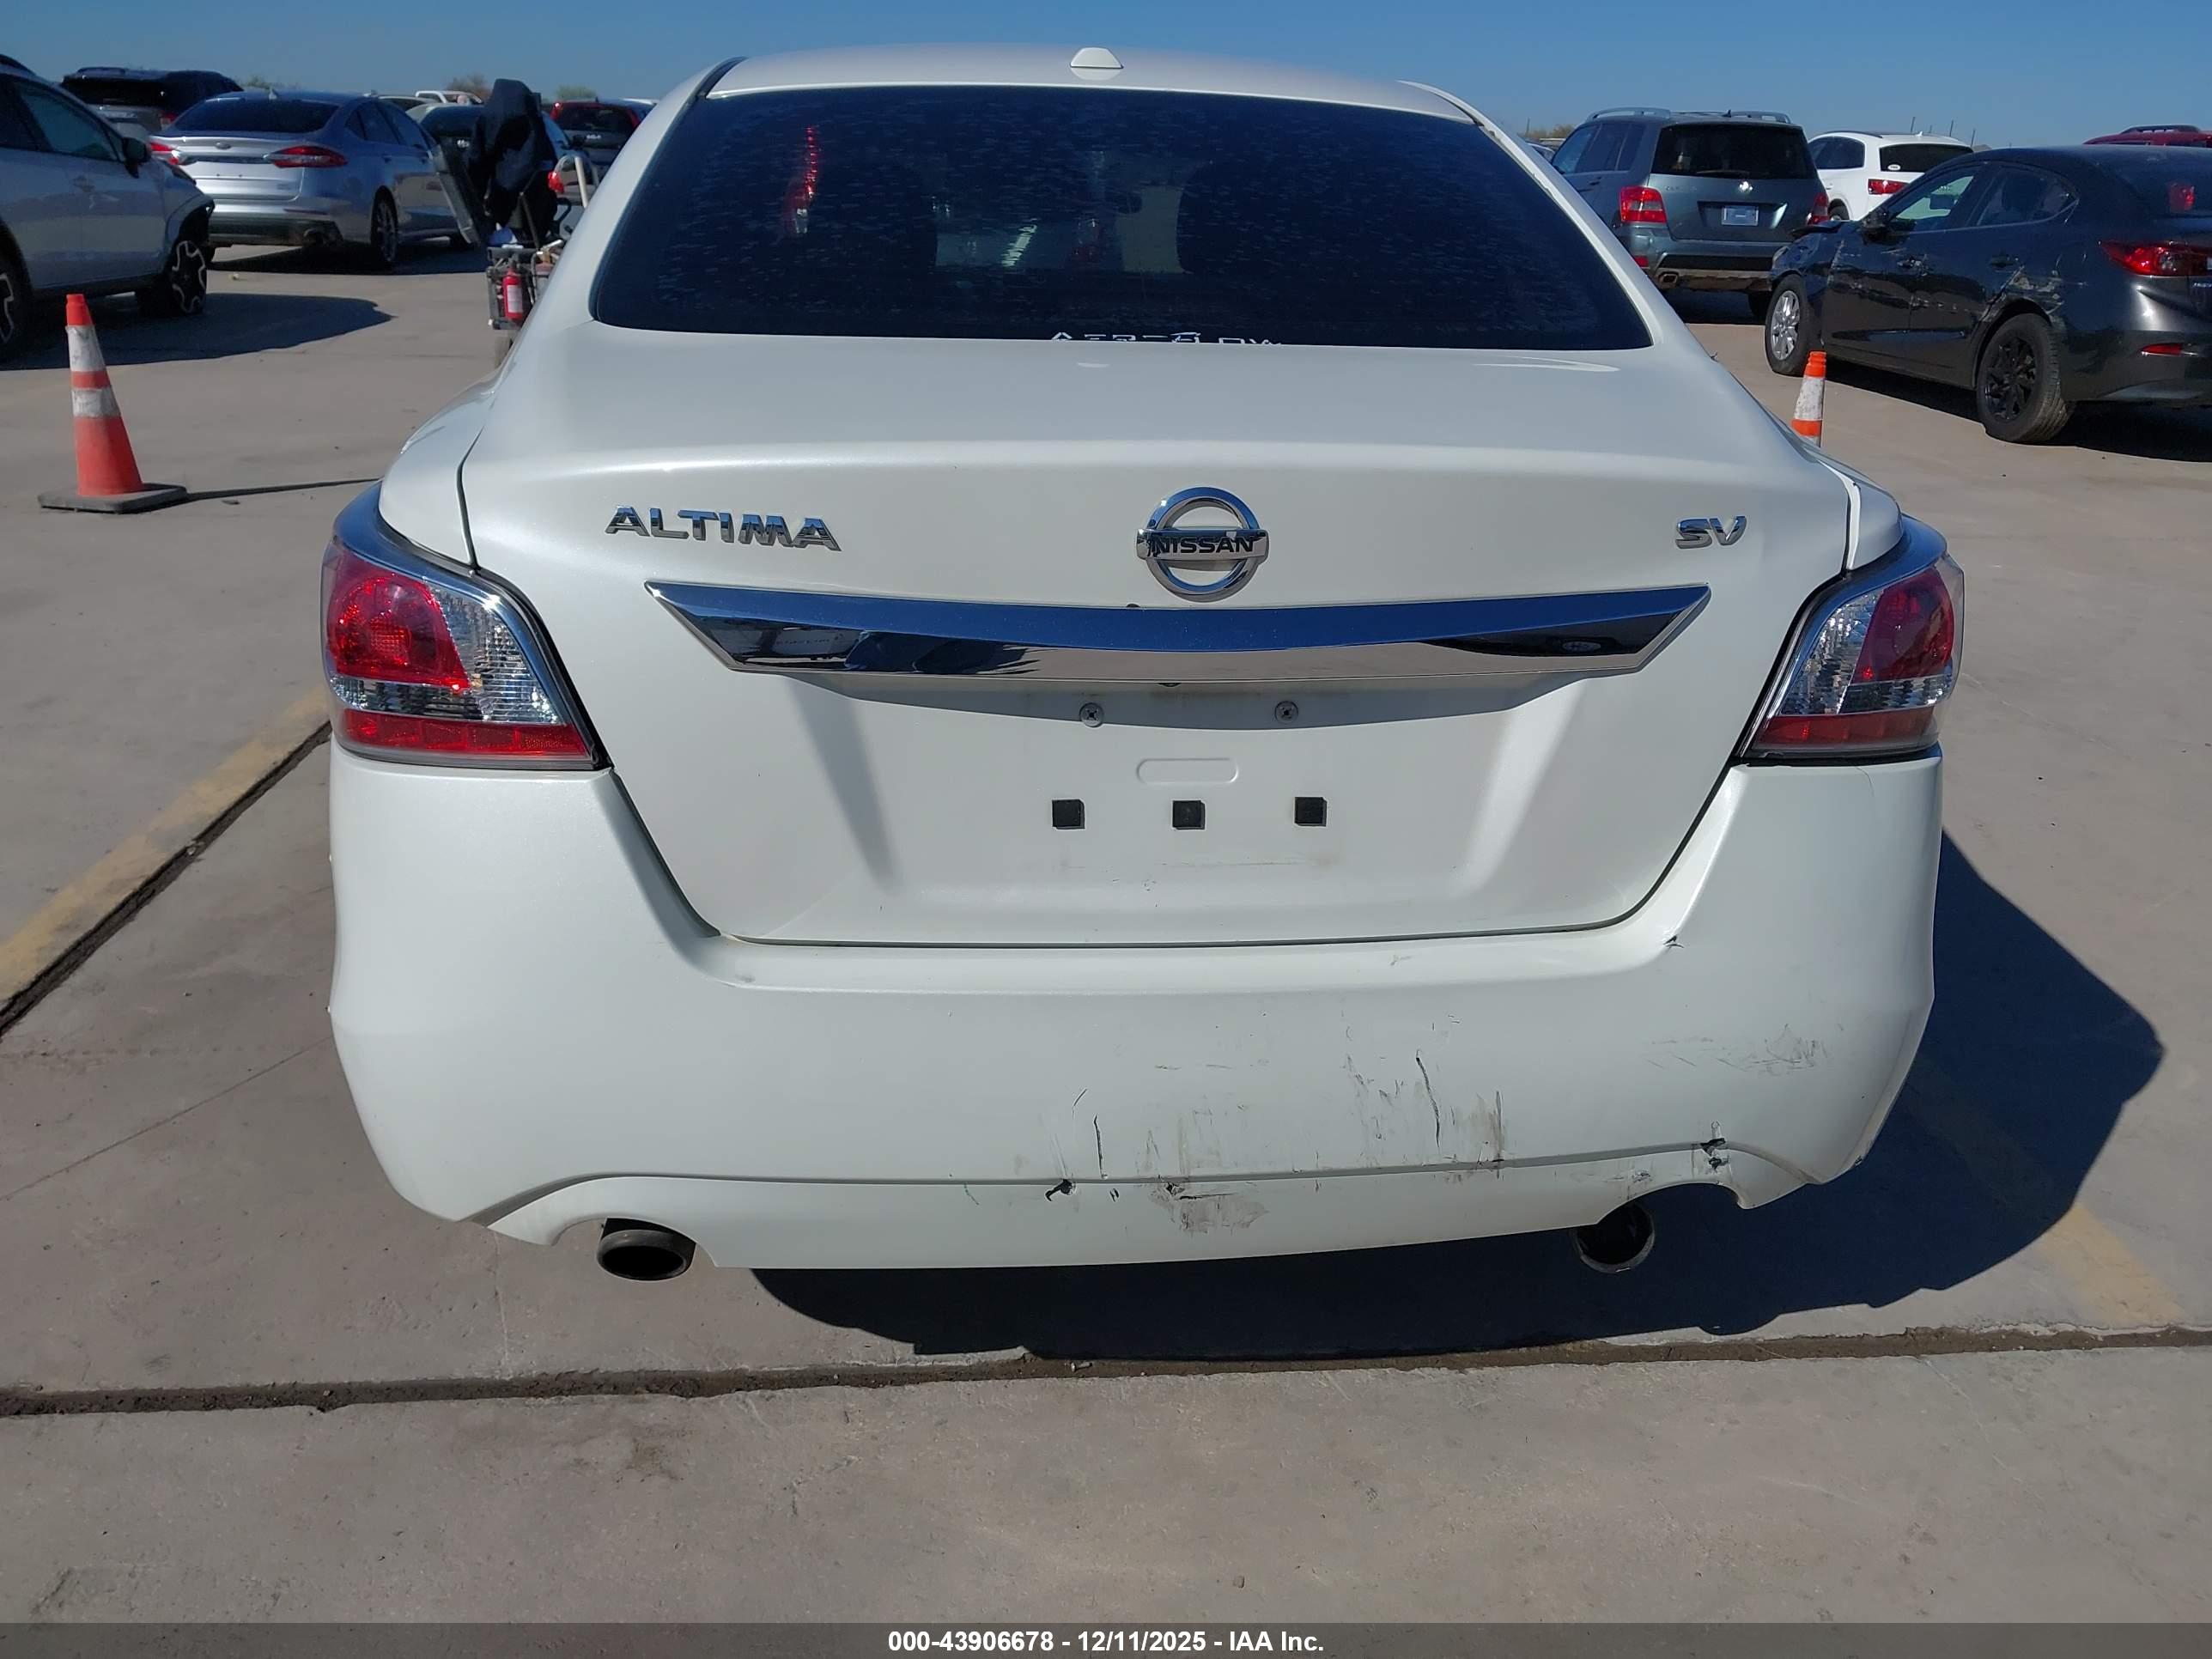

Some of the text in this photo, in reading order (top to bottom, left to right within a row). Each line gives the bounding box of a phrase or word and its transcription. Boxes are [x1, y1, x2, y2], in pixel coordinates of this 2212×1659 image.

[605, 505, 842, 552] ALTIMA
[1149, 535, 1257, 555] NISSAN
[1674, 515, 1747, 550] SV
